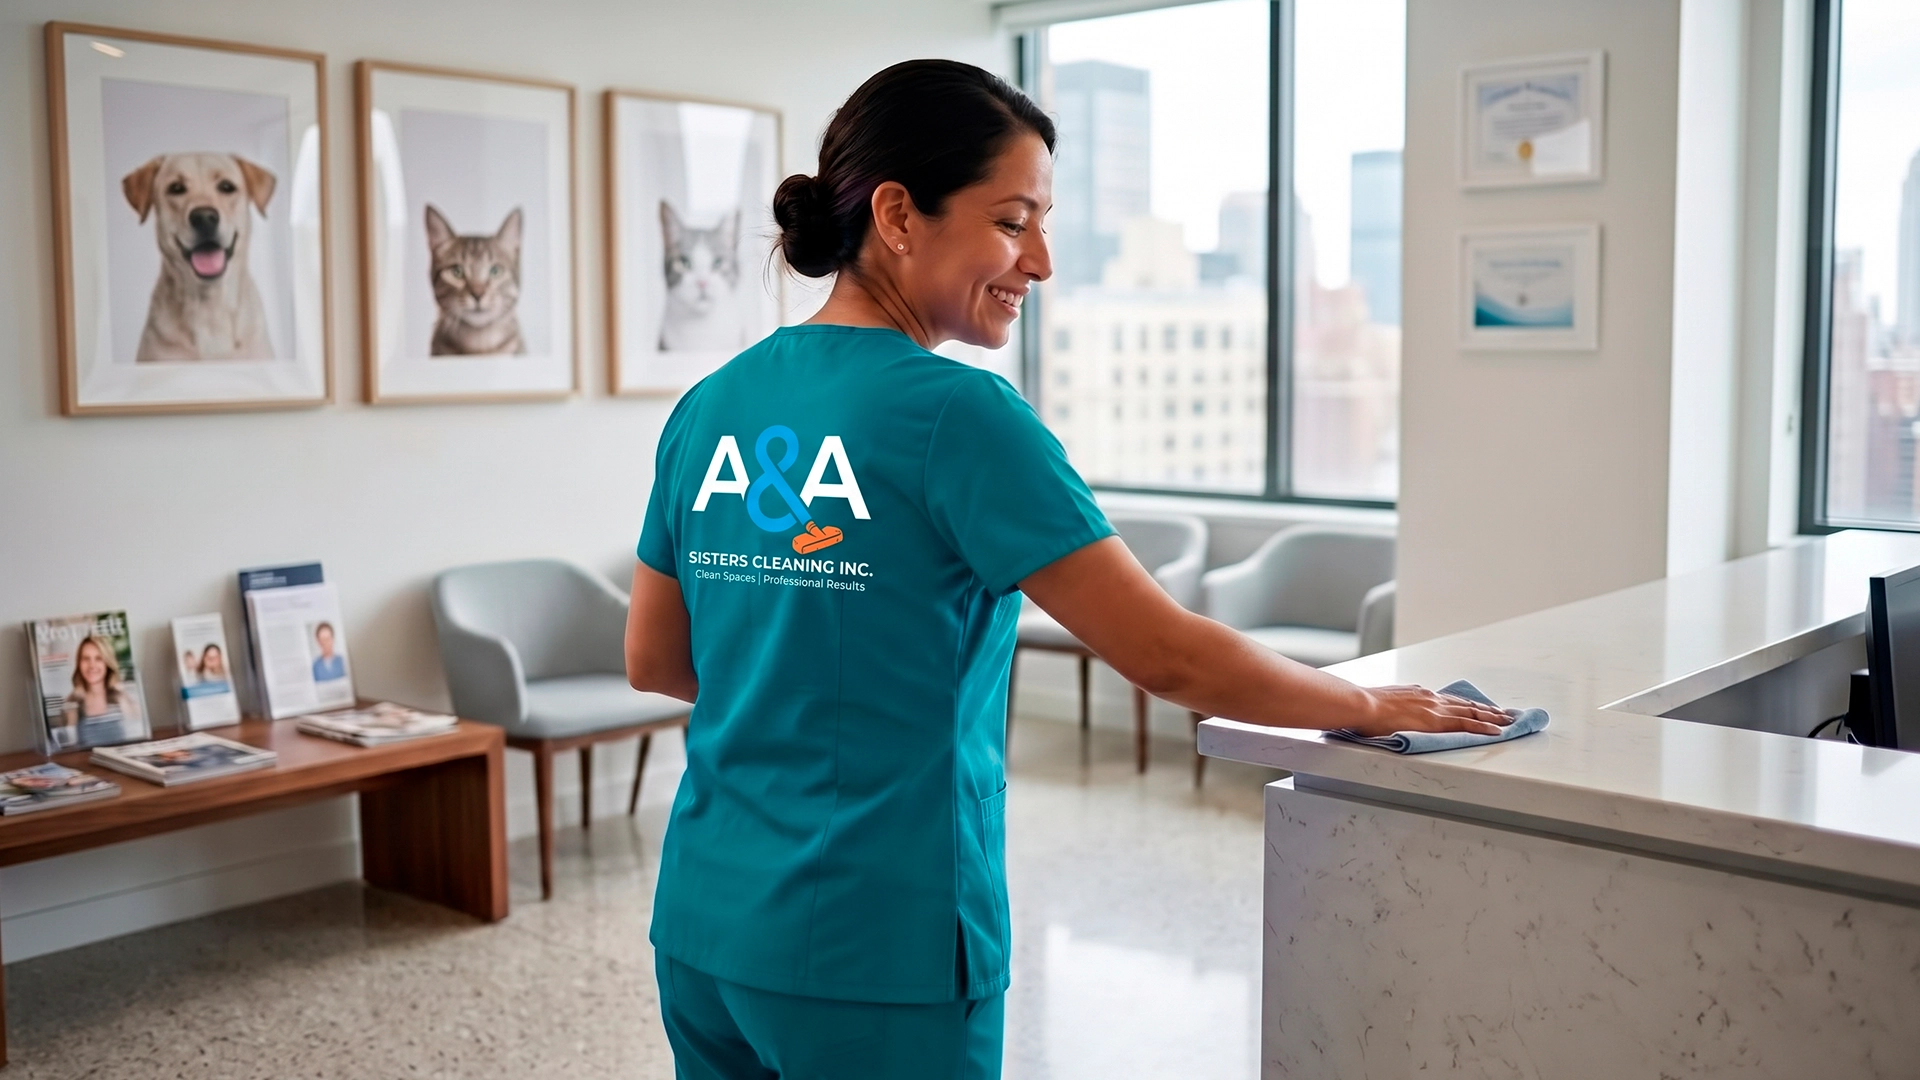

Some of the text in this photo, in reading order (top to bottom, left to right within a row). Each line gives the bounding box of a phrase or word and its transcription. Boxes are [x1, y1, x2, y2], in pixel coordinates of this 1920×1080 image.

[691, 424, 872, 533] A&A
[688, 551, 874, 577] SISTERS CLEANING INC.
[695, 569, 721, 580] Clean
[723, 571, 756, 583] Spaces
[763, 574, 824, 588] Professional
[827, 579, 866, 592] Results
